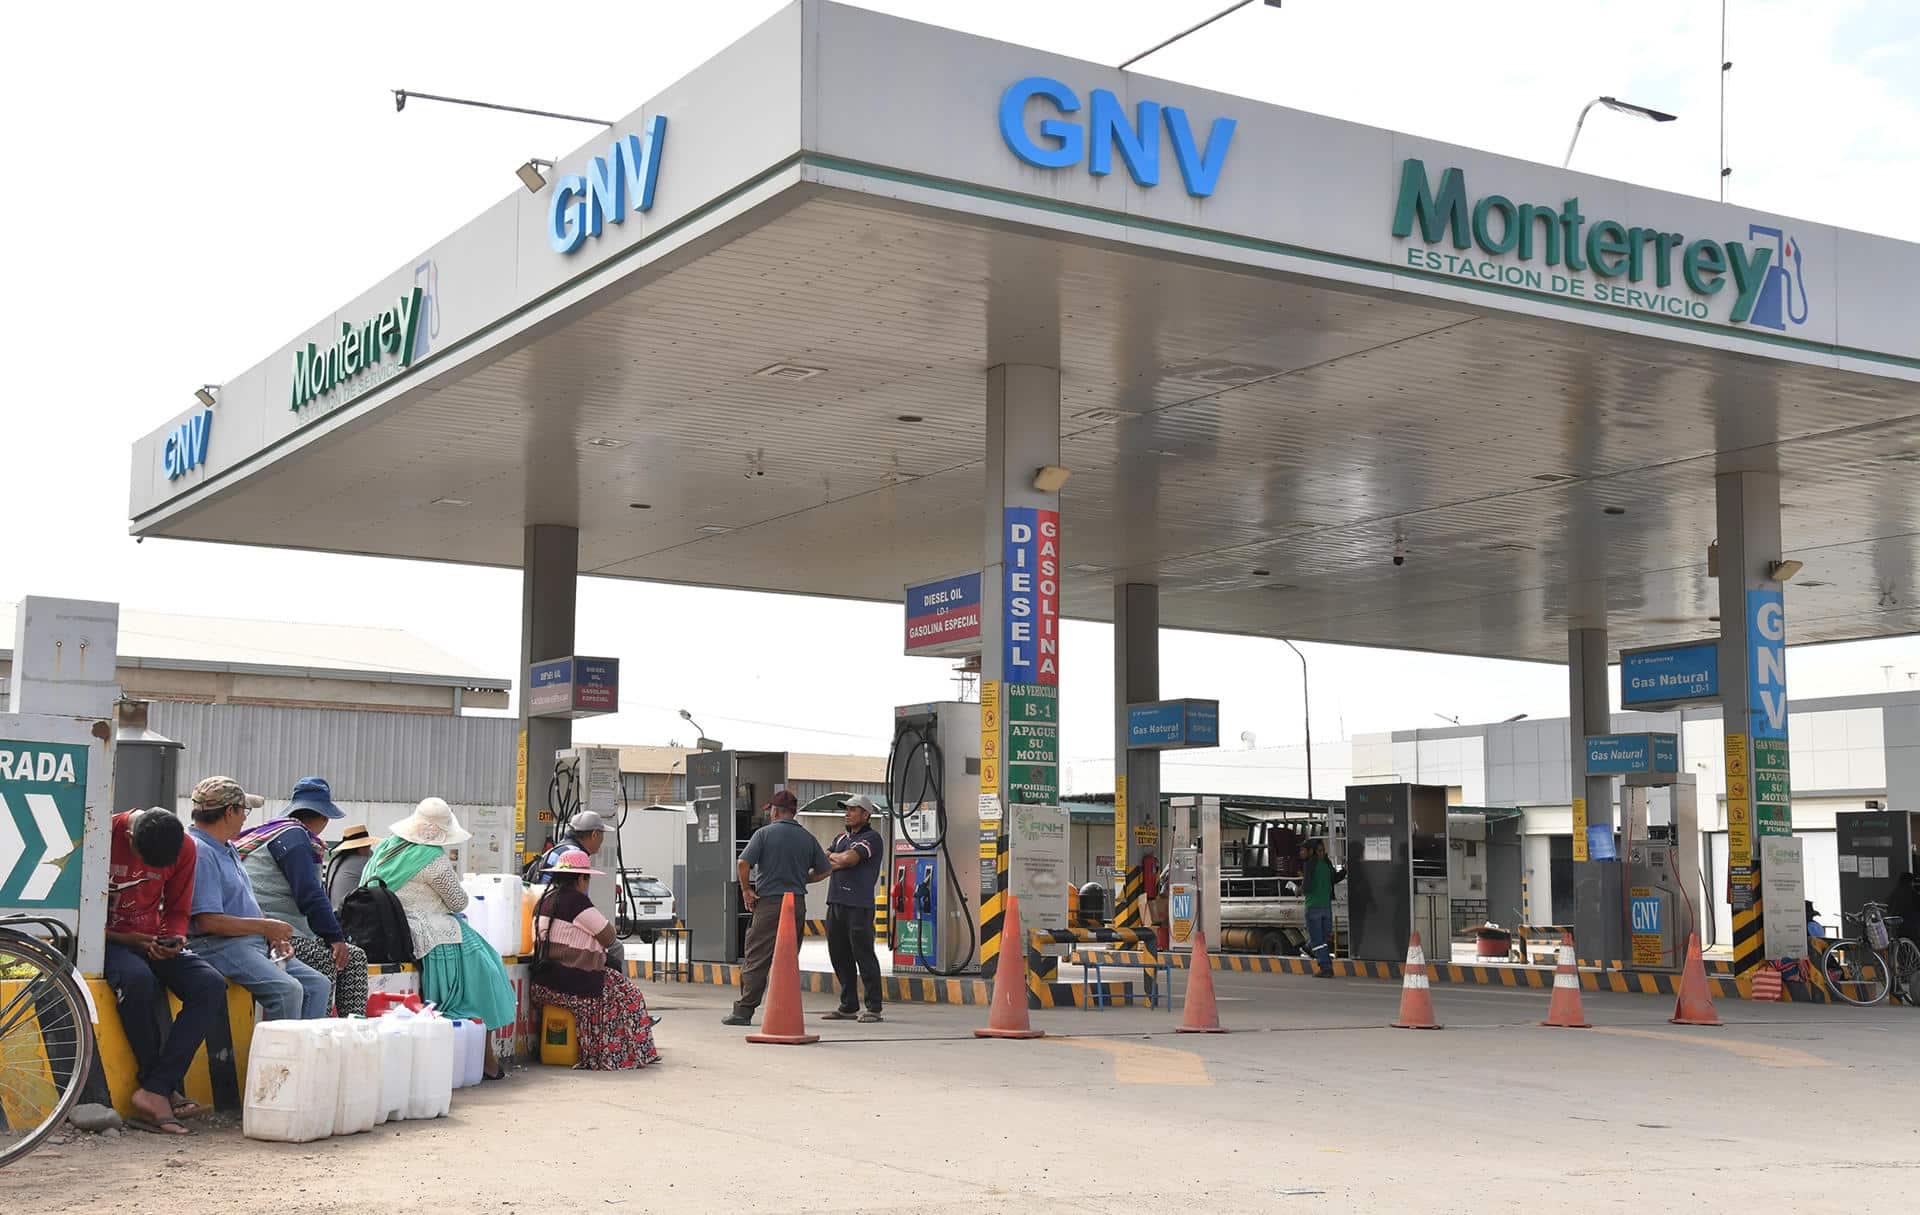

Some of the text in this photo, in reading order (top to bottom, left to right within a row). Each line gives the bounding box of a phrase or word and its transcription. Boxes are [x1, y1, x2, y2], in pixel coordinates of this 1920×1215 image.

[998, 76, 1237, 199] GNV
[549, 113, 668, 255] GNV
[1392, 158, 1772, 323] Monterrey
[1407, 248, 1710, 321] ESTACION DE SERVICIO
[289, 286, 423, 413] Monterrey
[163, 408, 213, 481] GNV
[923, 588, 963, 607] DIESEL OIL
[1010, 524, 1032, 666] DIESEL
[1040, 522, 1056, 674] GASOLINA
[909, 614, 979, 639] GASOLINA ESPECIAL
[1757, 602, 1786, 730] GNV
[1010, 684, 1026, 697] GAS
[1631, 670, 1709, 689] Gas Natural
[1691, 683, 1710, 694] LD-1
[1012, 726, 1056, 738] APAGUE
[1133, 722, 1179, 736] Gas Natural
[1028, 738, 1044, 749] SU
[1591, 749, 1643, 761] Gas Natural
[1016, 750, 1054, 761] MOTOR
[1770, 783, 1783, 792] SU
[1030, 822, 1064, 833] ANH
[1172, 895, 1191, 918] GNV
[1632, 902, 1659, 931] GNV
